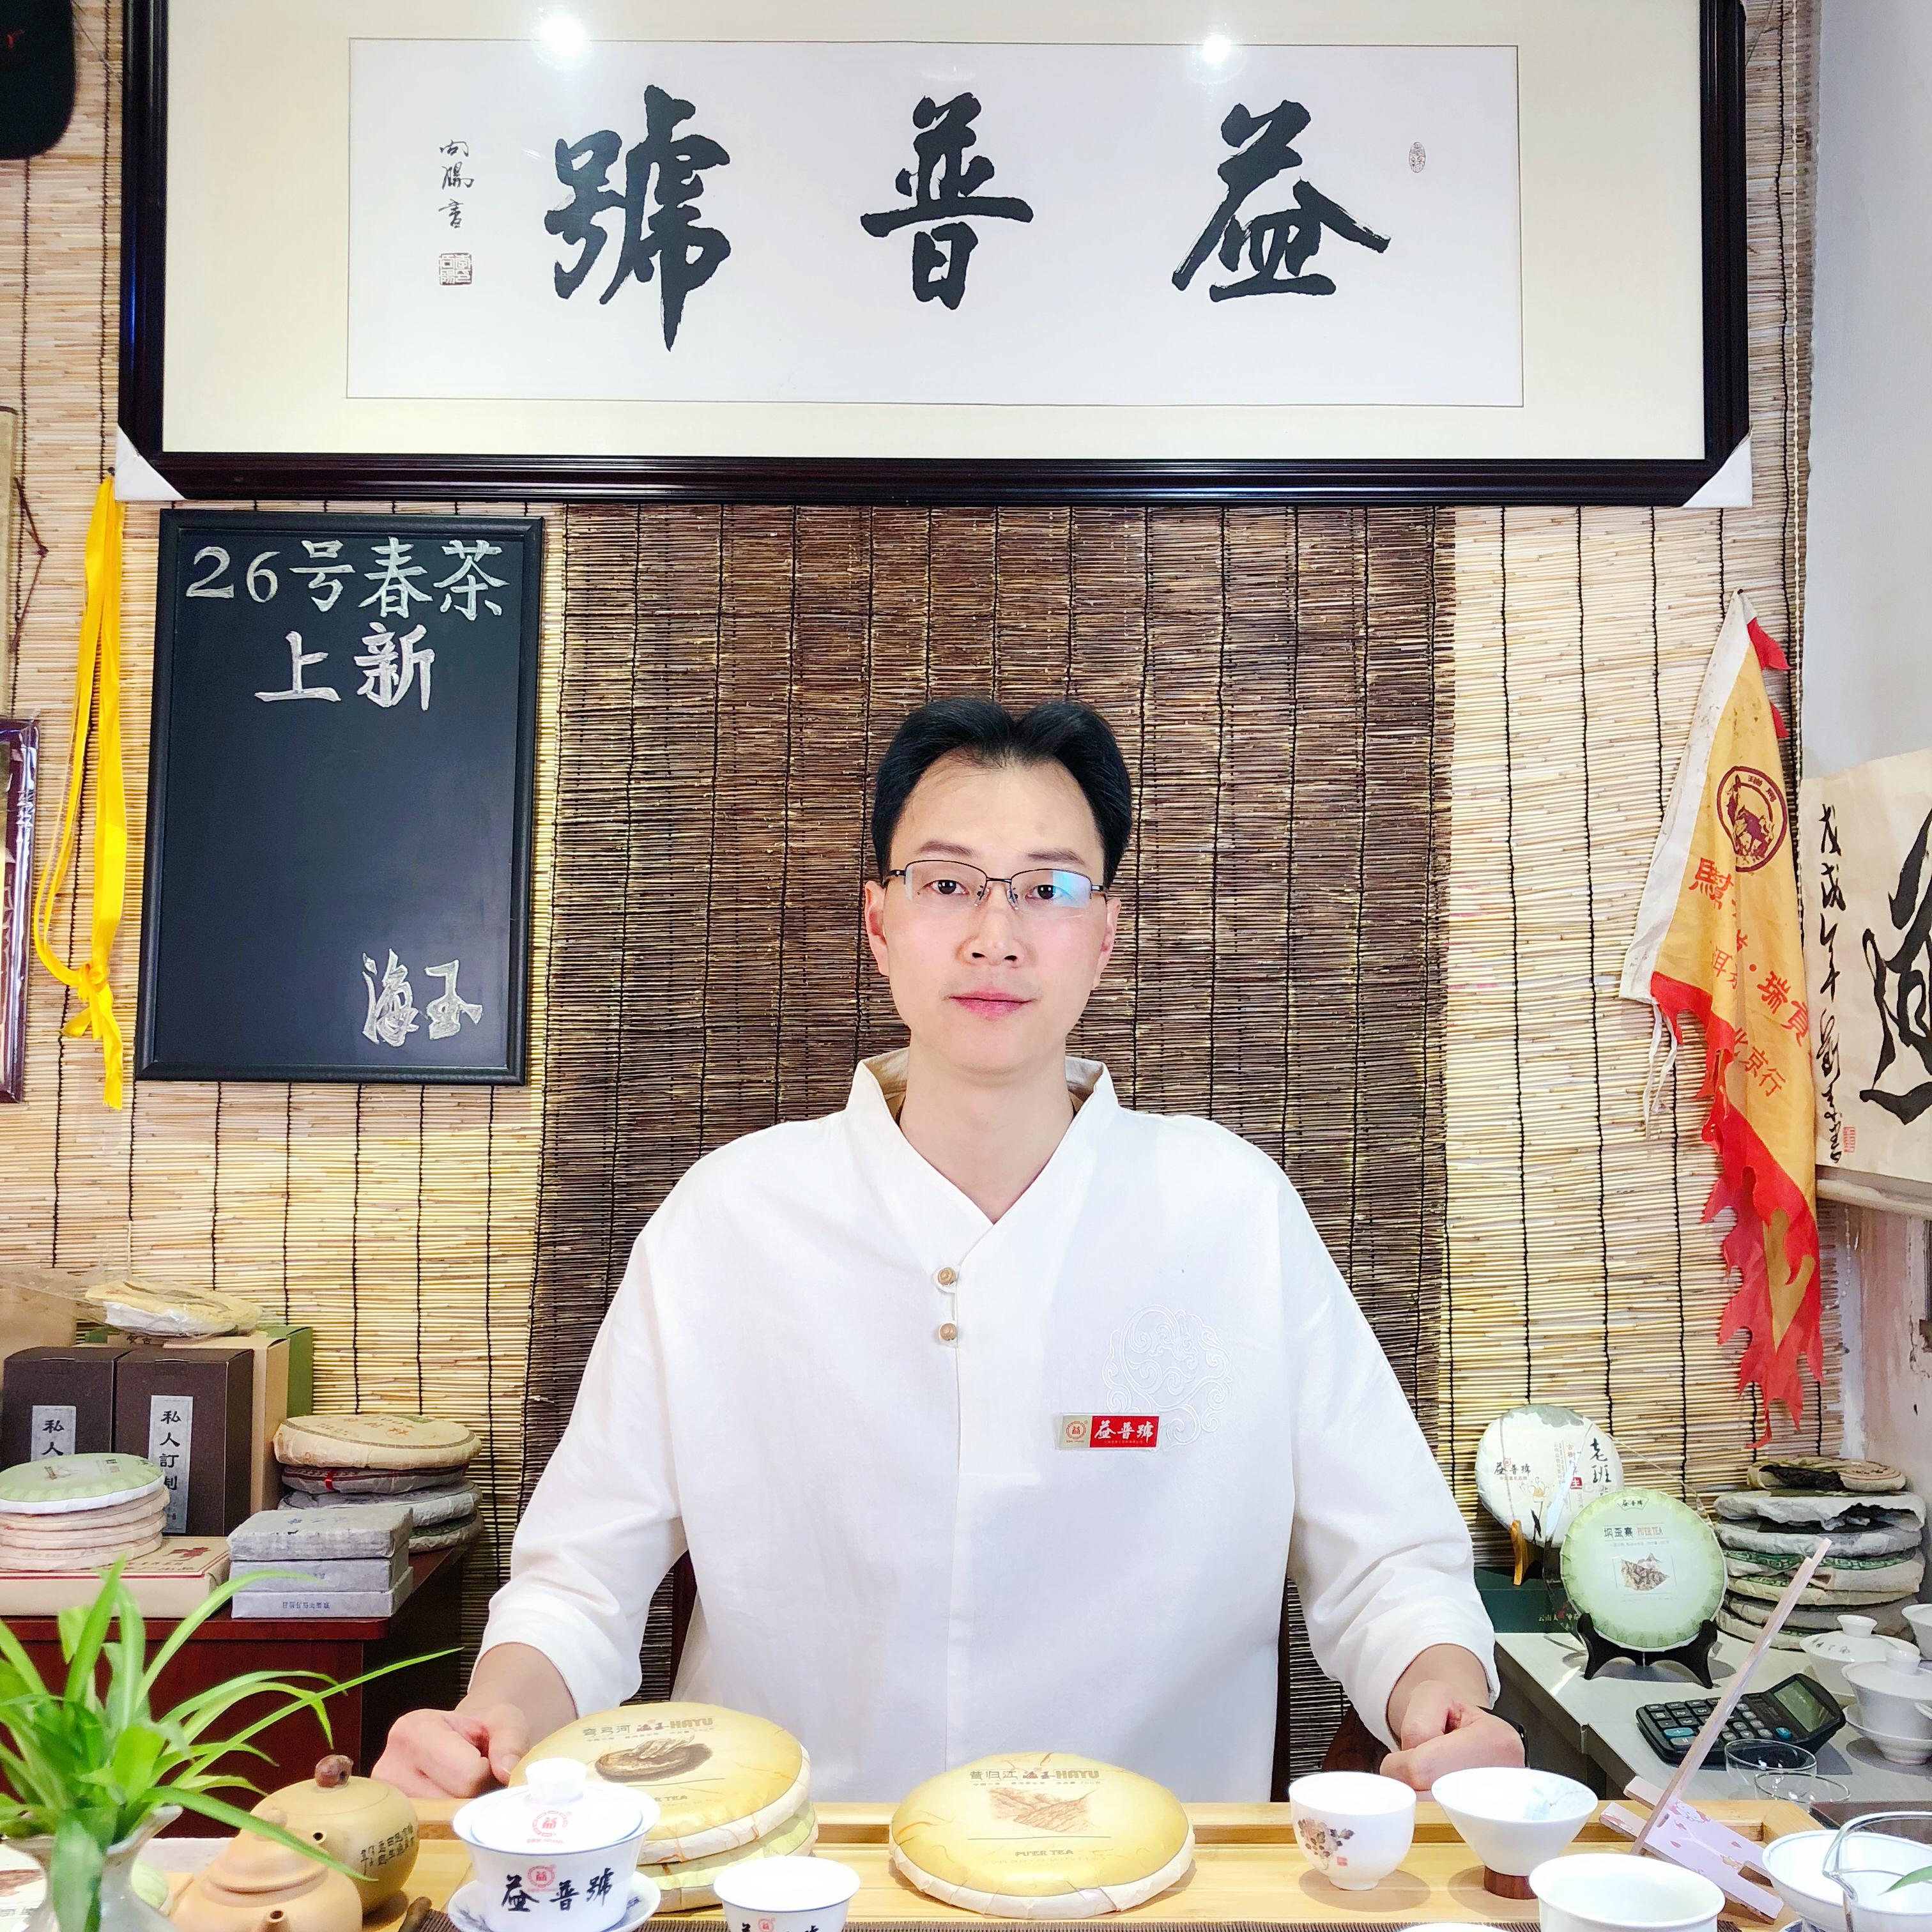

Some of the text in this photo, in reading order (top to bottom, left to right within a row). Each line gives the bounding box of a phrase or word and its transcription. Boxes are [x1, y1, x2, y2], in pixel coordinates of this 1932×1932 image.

[185, 537, 509, 621] 26号春茶
[254, 622, 436, 711] 上新
[1094, 1420, 1154, 1443] 益普號
[670, 1717, 714, 1729] HAYU
[1055, 1770, 1100, 1779] HAYU
[501, 1867, 615, 1912] 益普號
